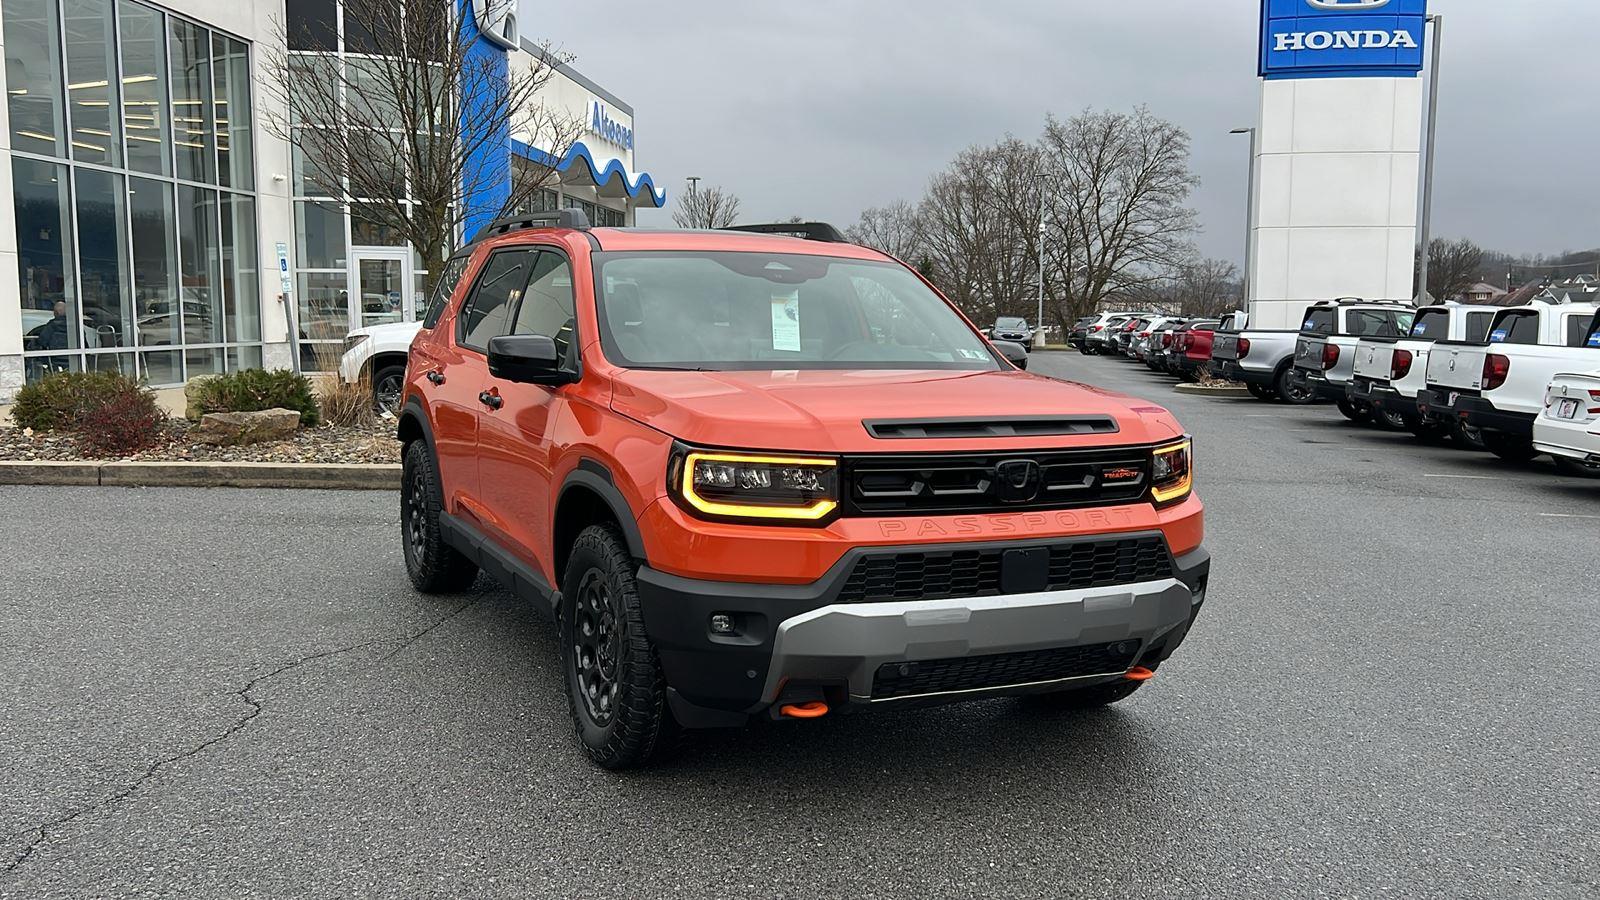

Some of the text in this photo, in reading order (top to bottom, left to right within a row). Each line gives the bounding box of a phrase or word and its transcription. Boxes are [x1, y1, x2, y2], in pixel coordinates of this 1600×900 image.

[1274, 30, 1417, 51] HONDA
[592, 101, 632, 150] Altoona
[878, 508, 1133, 537] PASSPORT
